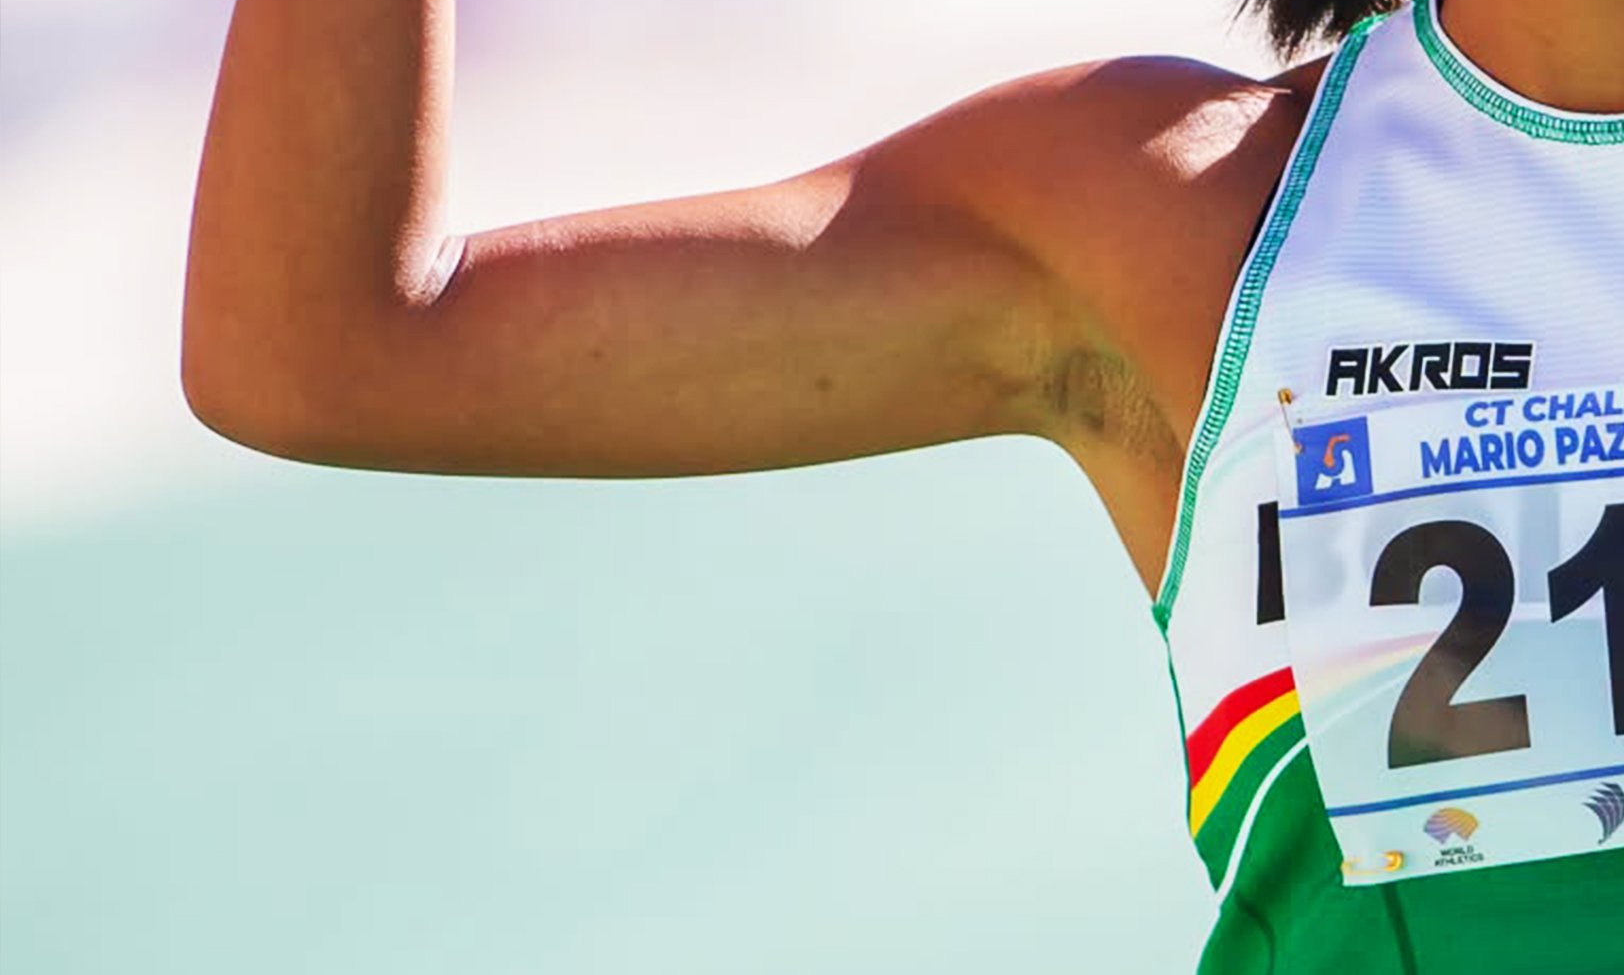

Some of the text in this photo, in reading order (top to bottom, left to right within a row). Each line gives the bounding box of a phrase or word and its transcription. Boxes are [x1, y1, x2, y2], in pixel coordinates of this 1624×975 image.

[1325, 342, 1533, 396] AKROS
[1464, 400, 1514, 428] CT
[1420, 429, 1546, 479] MARIO
